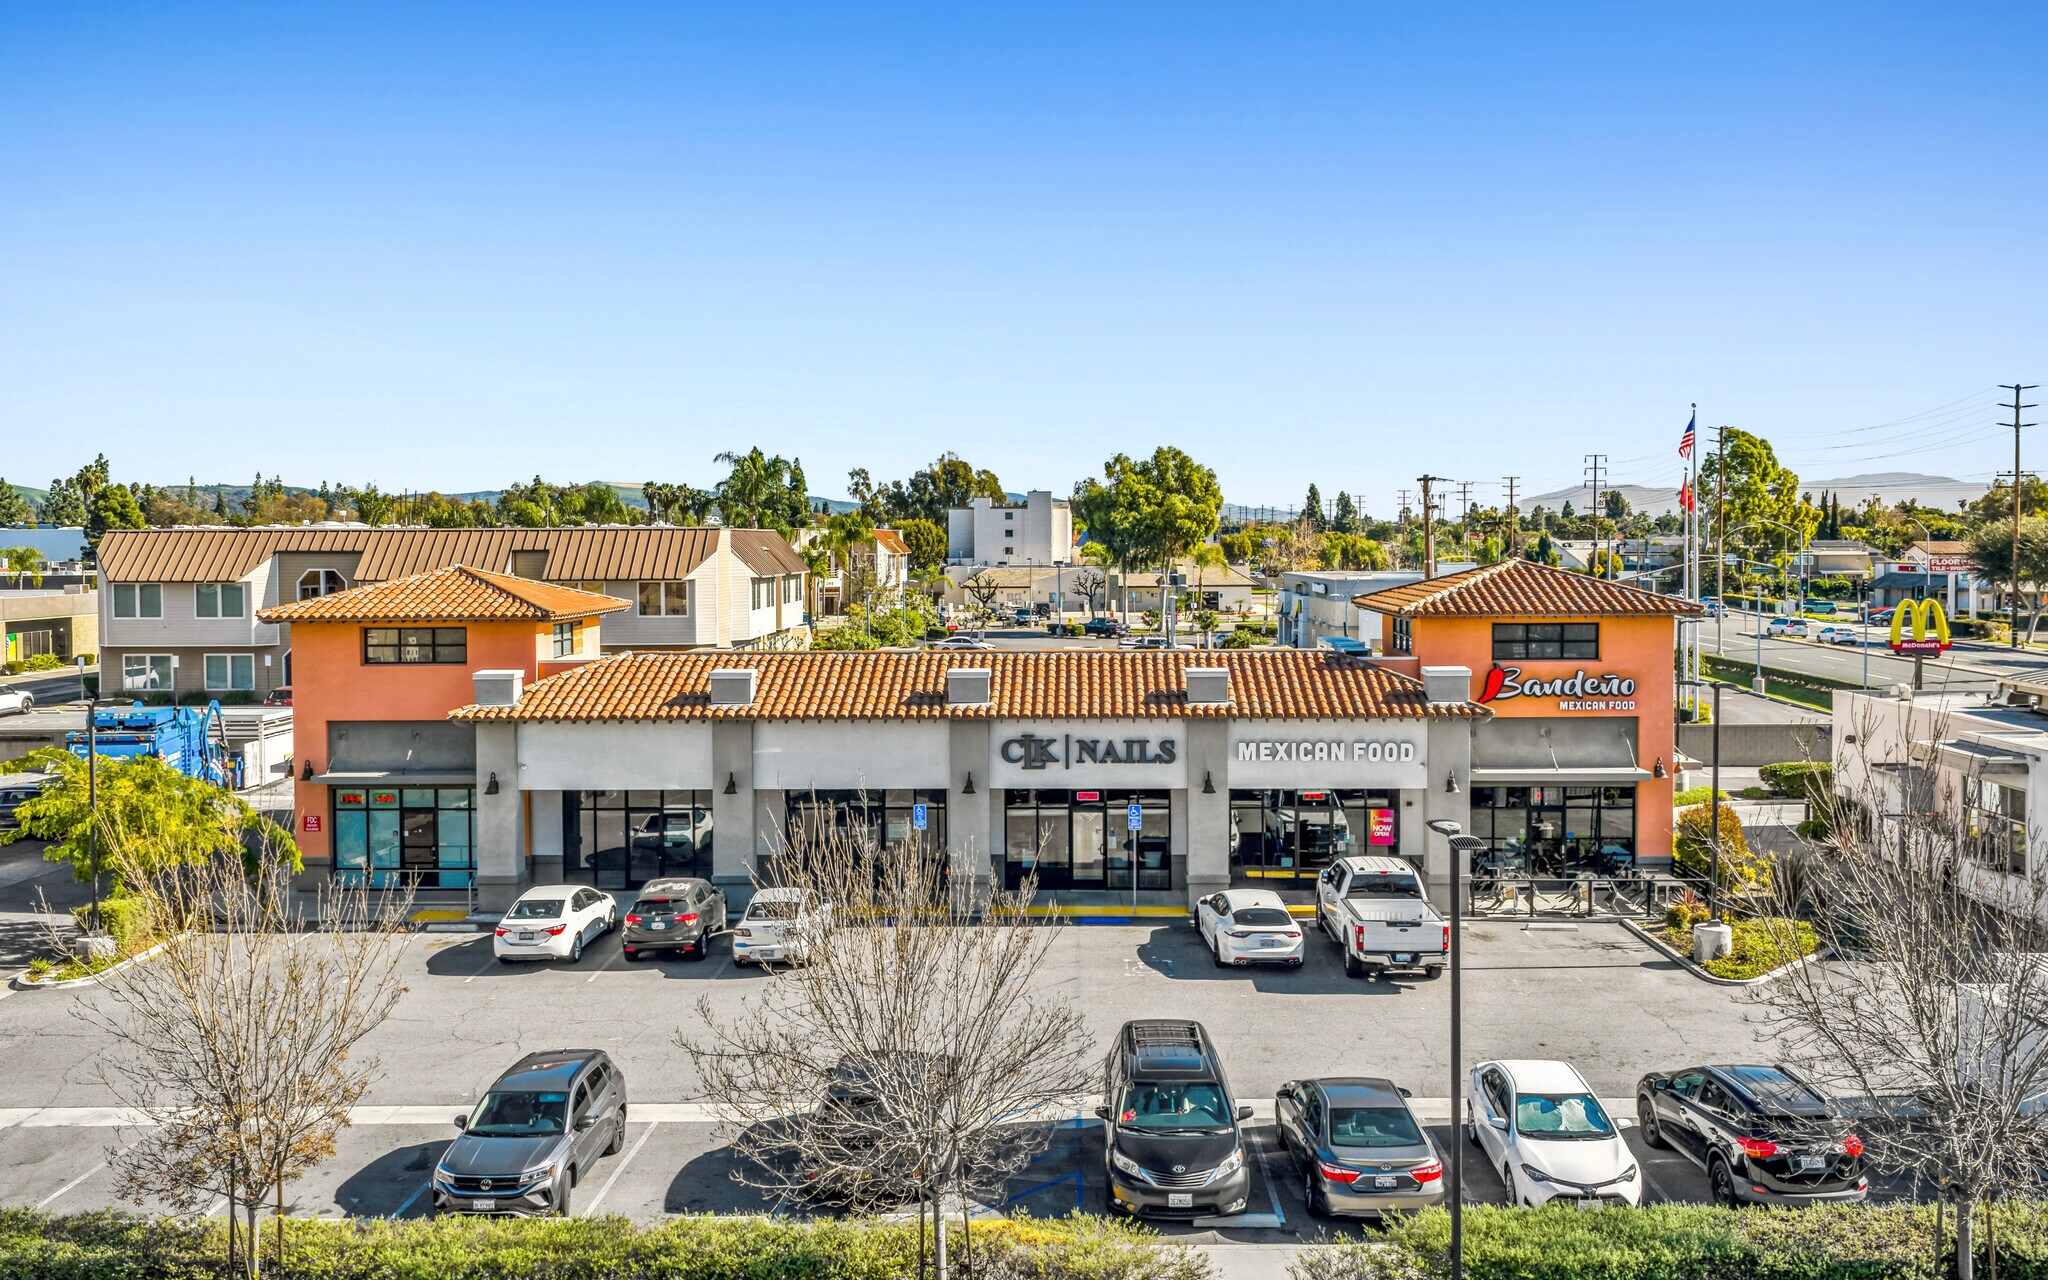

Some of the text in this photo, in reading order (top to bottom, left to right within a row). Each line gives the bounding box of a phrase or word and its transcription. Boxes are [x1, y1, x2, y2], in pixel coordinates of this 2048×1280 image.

[1494, 667, 1636, 699] Bandeño
[1559, 701, 1635, 710] MEXICAN FOOD
[1075, 739, 1176, 765] NAILS
[1238, 742, 1415, 762] MEXICAN FOOD
[375, 795, 395, 803] SPA
[307, 816, 318, 824] FDC
